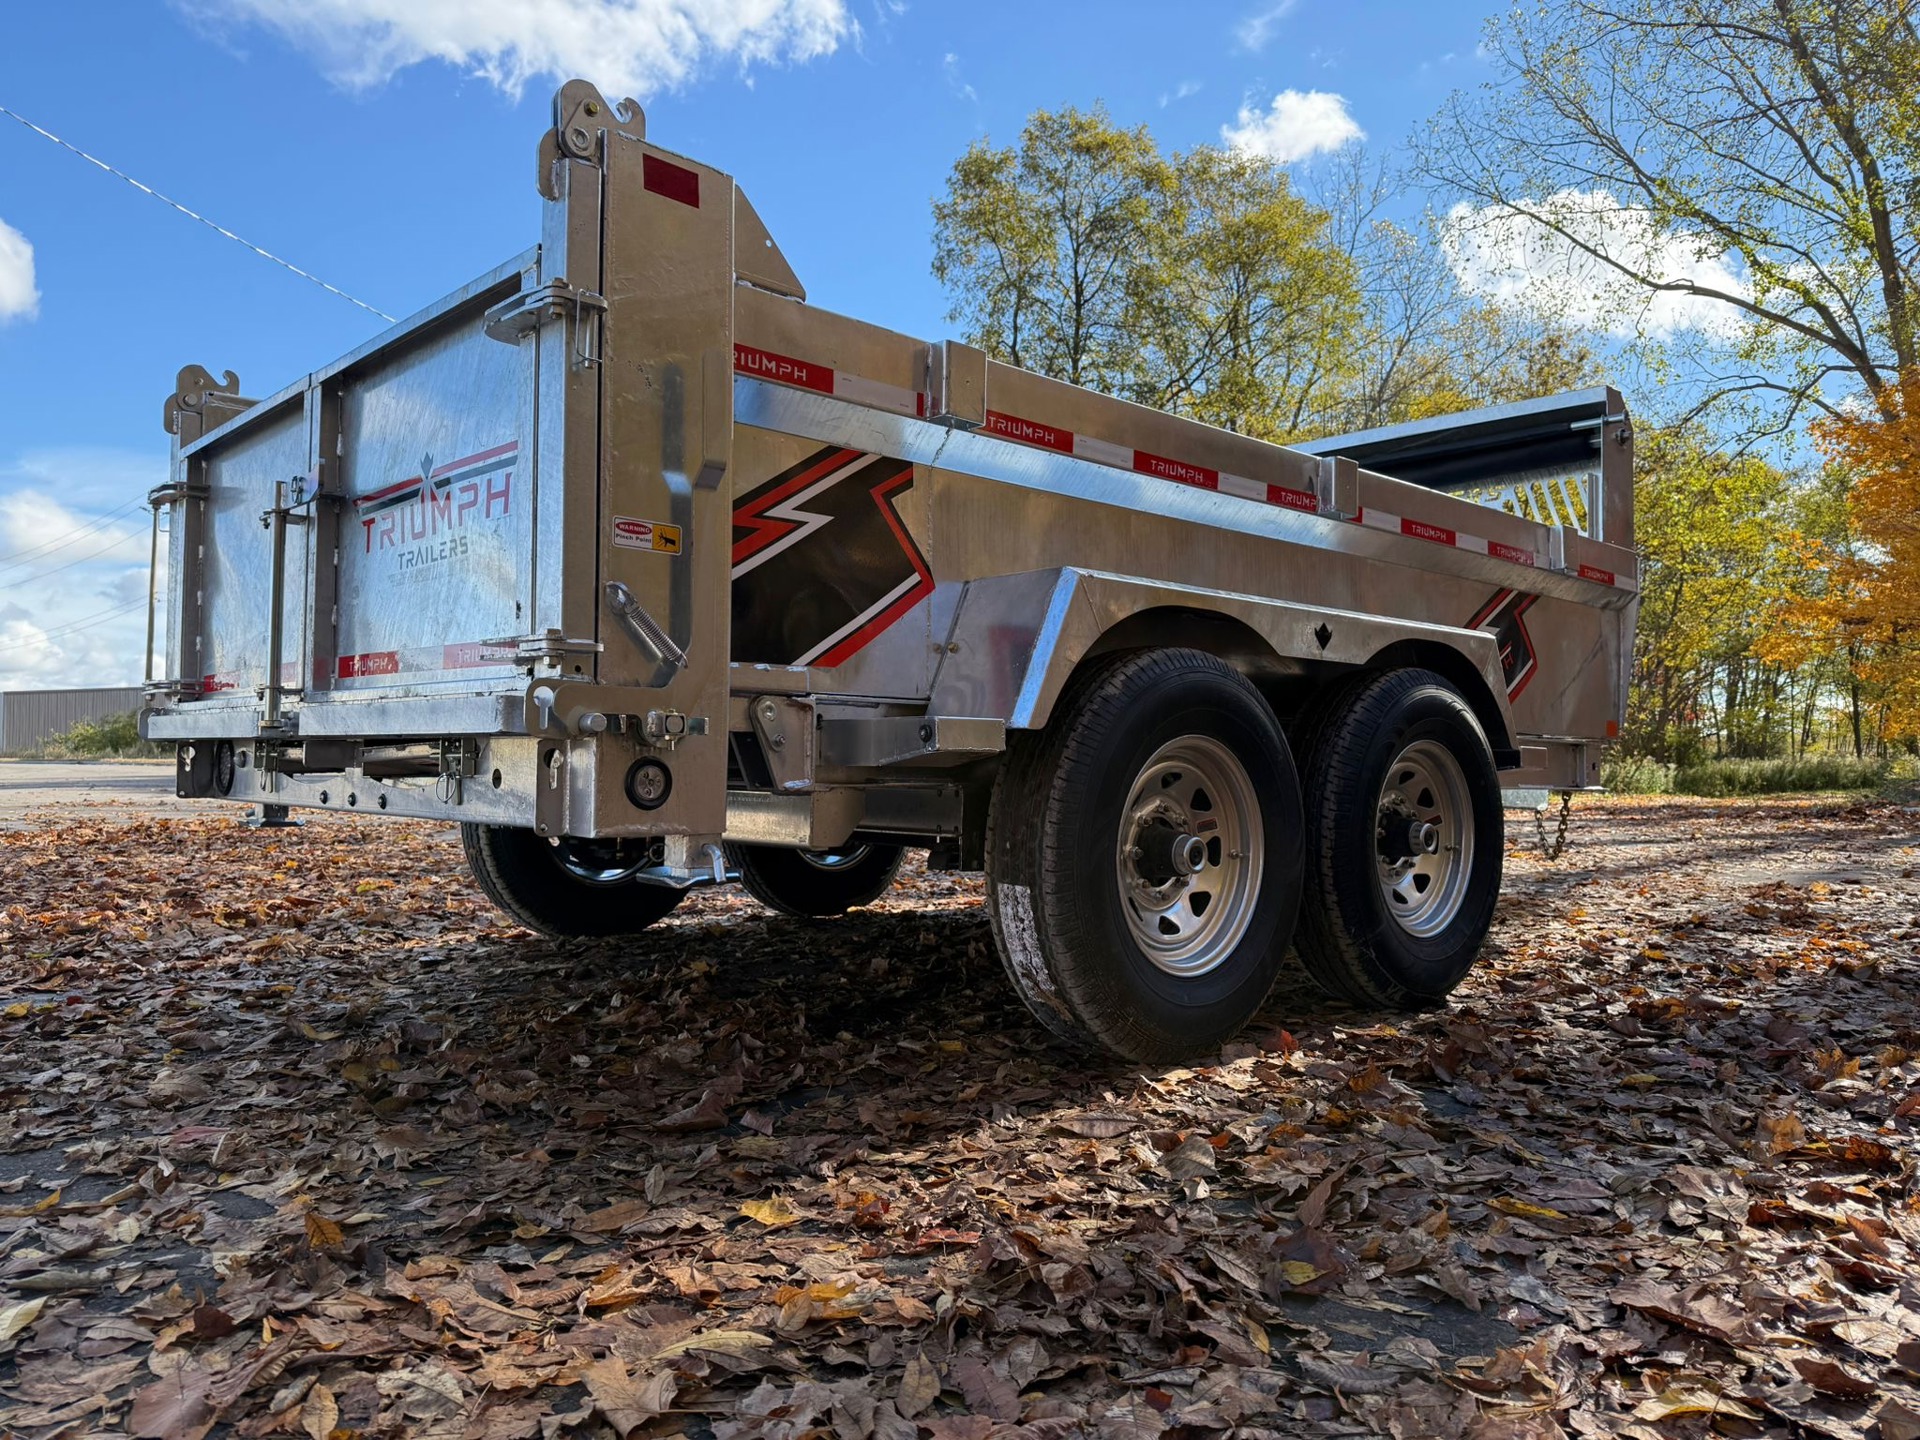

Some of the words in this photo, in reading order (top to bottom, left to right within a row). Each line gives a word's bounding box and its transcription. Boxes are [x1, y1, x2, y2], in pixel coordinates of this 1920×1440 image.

[988, 416, 1055, 444] TRIUMPH
[1150, 459, 1204, 482] TRIUMPH
[361, 471, 513, 554] TRIUMPH
[615, 533, 634, 541] Pinch
[619, 524, 650, 534] WARNING
[1411, 524, 1446, 541] TRIUMPH
[398, 535, 469, 570] TRAILERS
